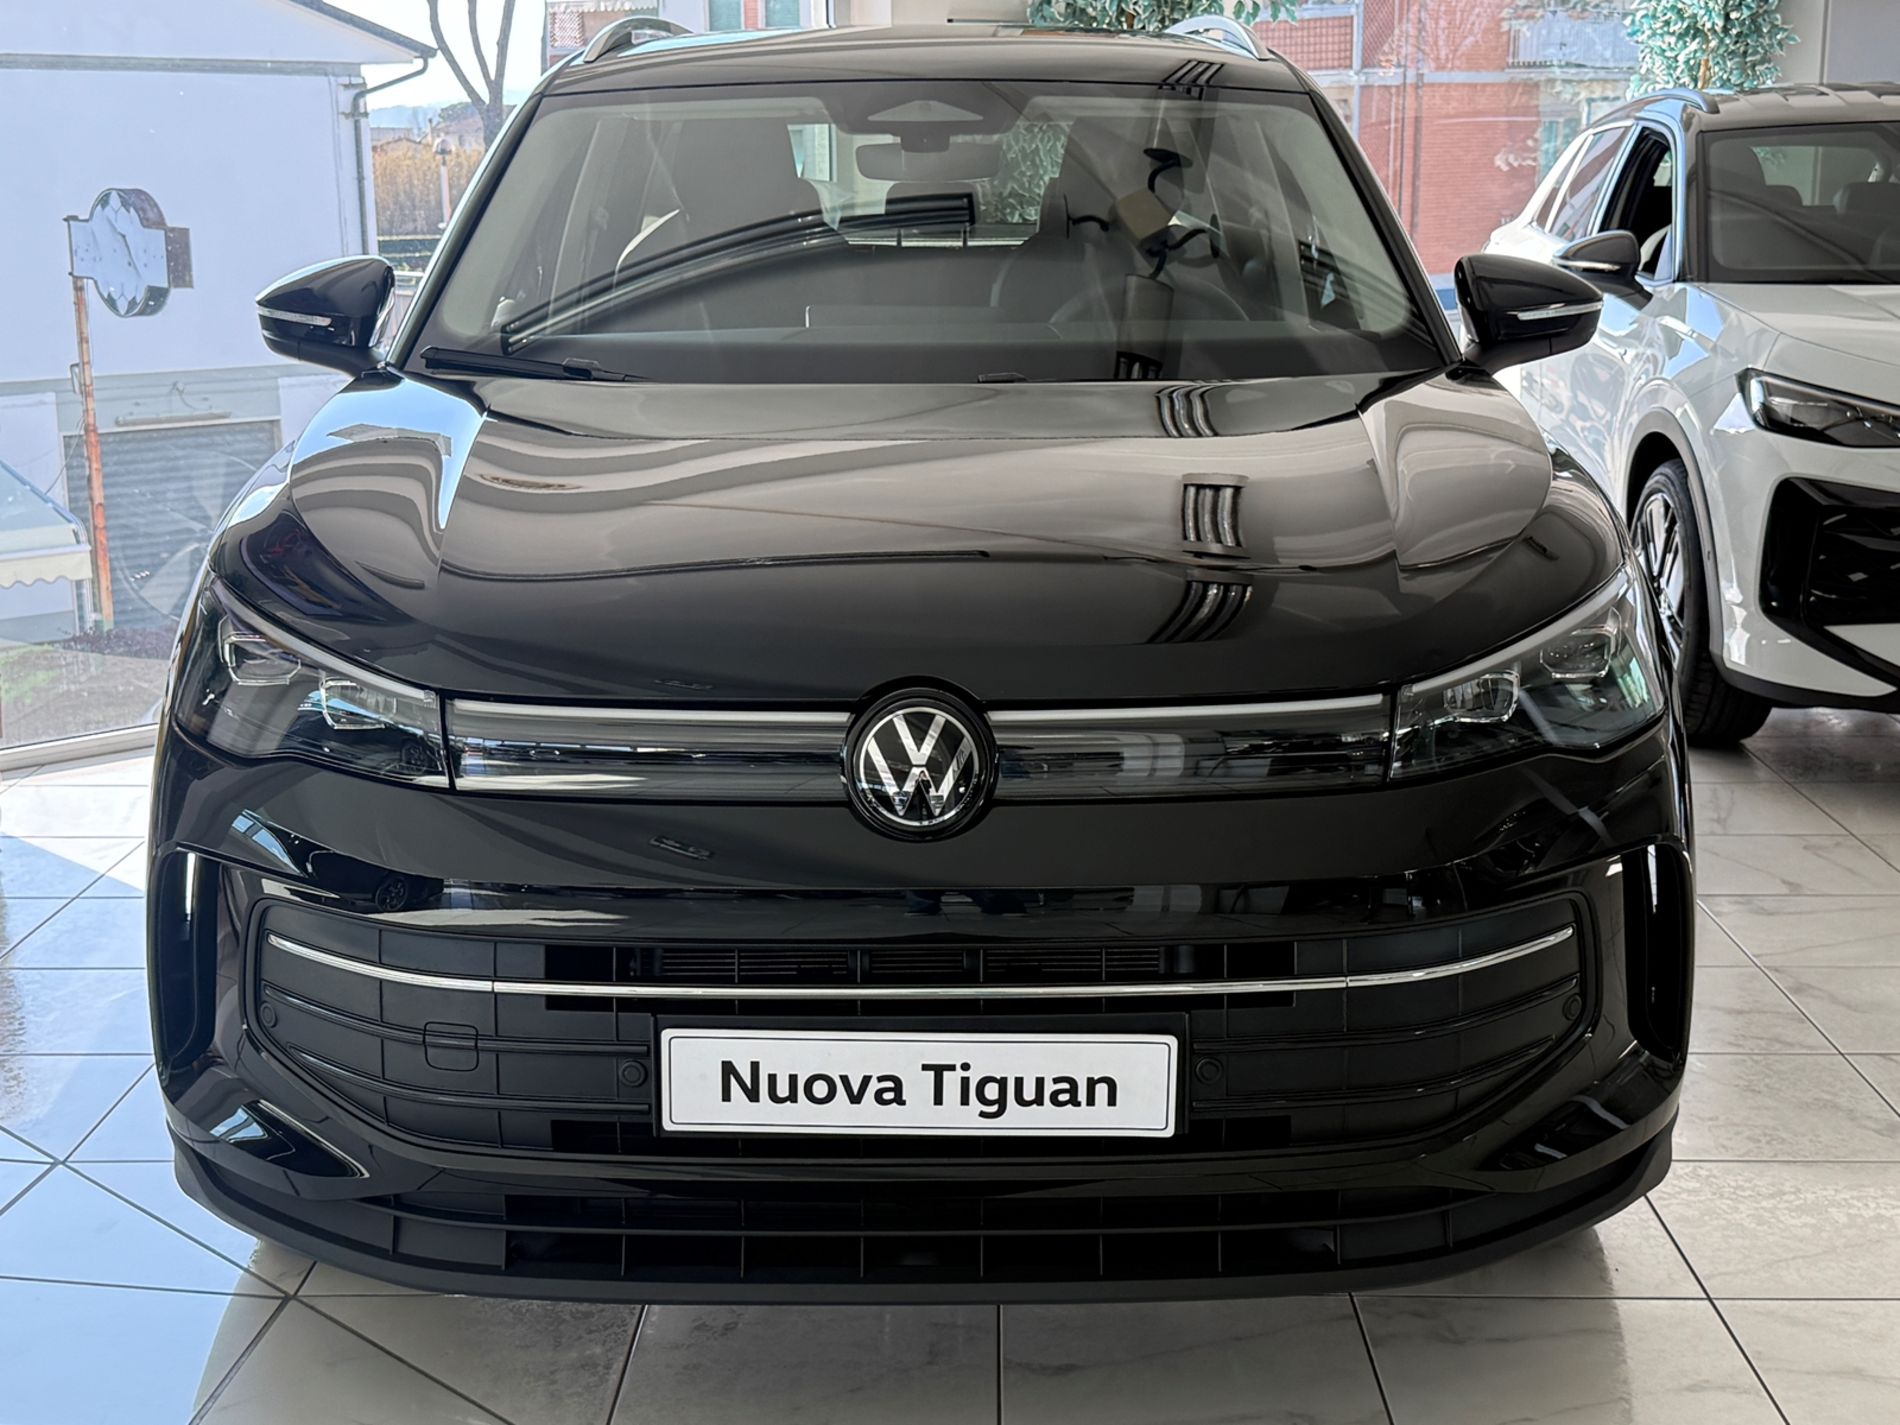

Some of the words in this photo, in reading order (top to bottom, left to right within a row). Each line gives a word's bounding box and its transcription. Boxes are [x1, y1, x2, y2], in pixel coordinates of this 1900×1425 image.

[861, 708, 977, 823] VW
[720, 1060, 907, 1107] Nuova
[921, 1062, 1118, 1120] Tiguan
